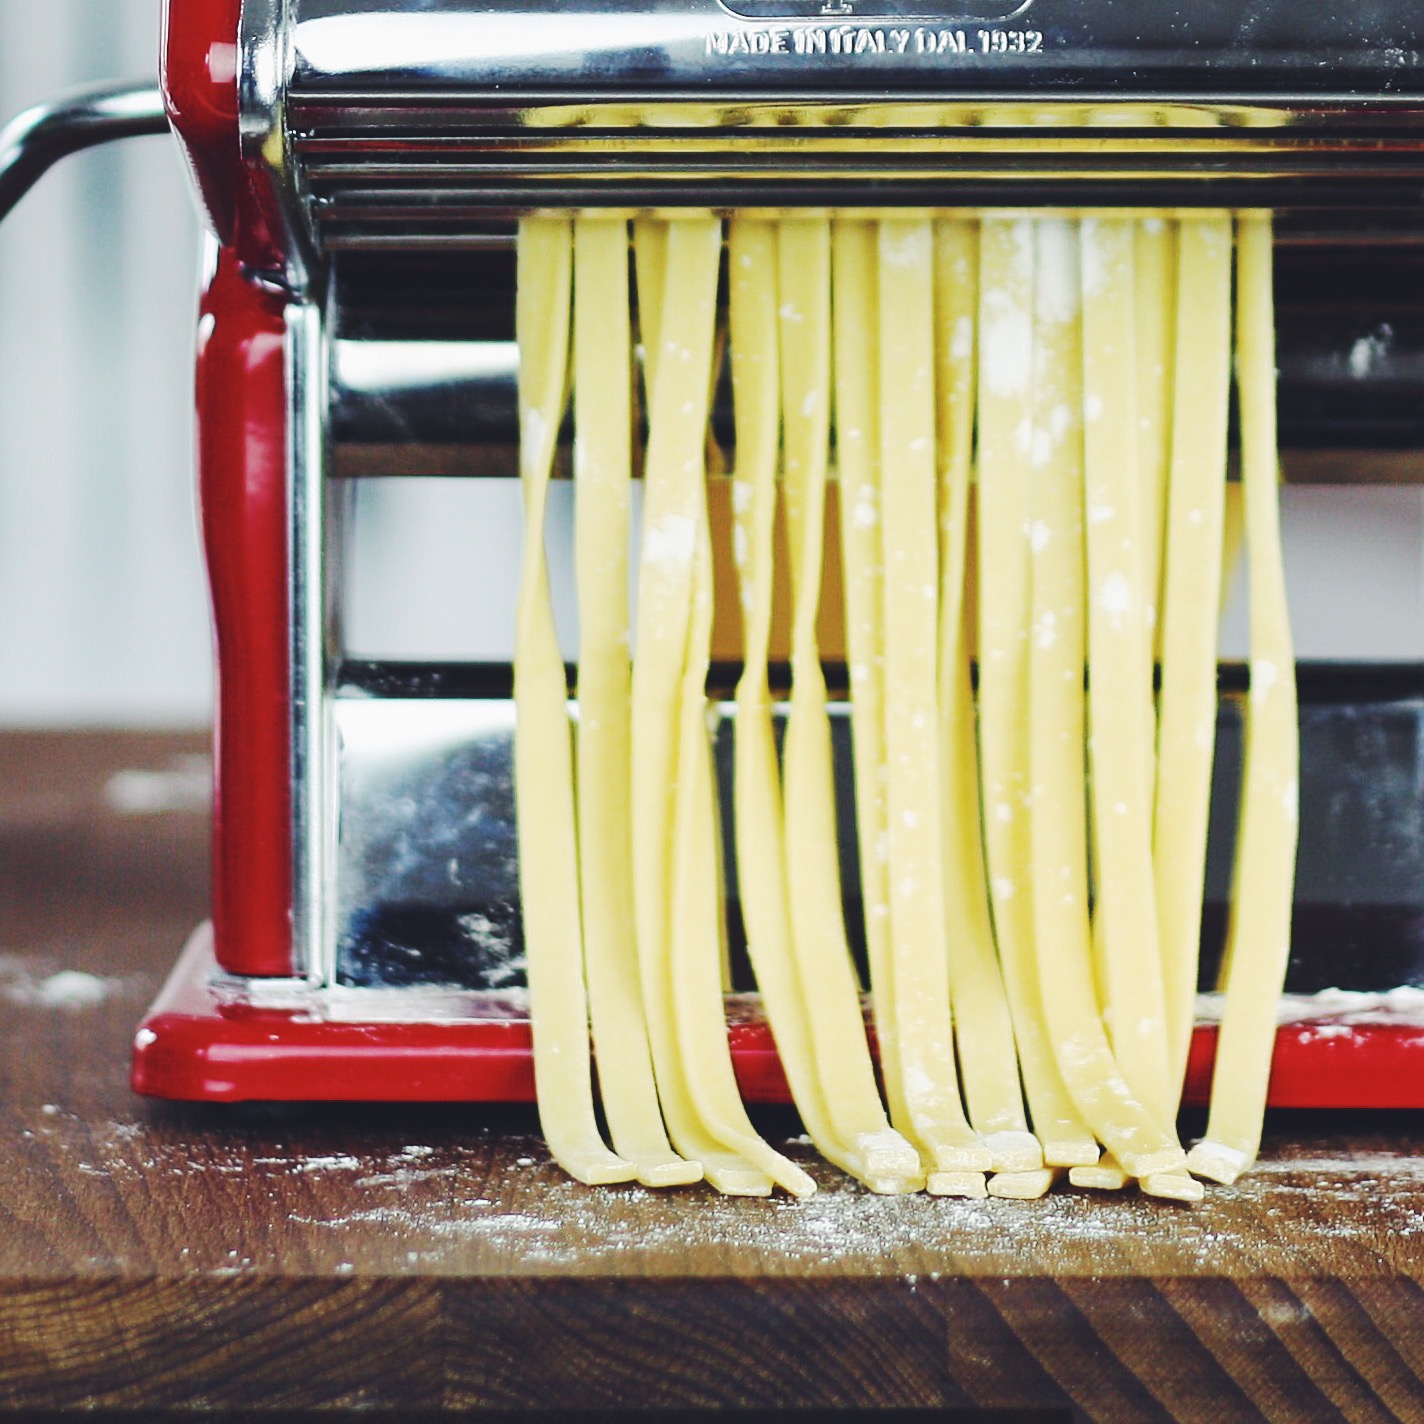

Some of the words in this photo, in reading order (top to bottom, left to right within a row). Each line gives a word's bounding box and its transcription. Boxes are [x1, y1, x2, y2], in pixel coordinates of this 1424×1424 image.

[705, 28, 790, 54] MADE
[793, 27, 826, 54] IN
[829, 26, 910, 54] ITALY
[914, 27, 975, 54] DAL
[978, 29, 1043, 54] 1932
